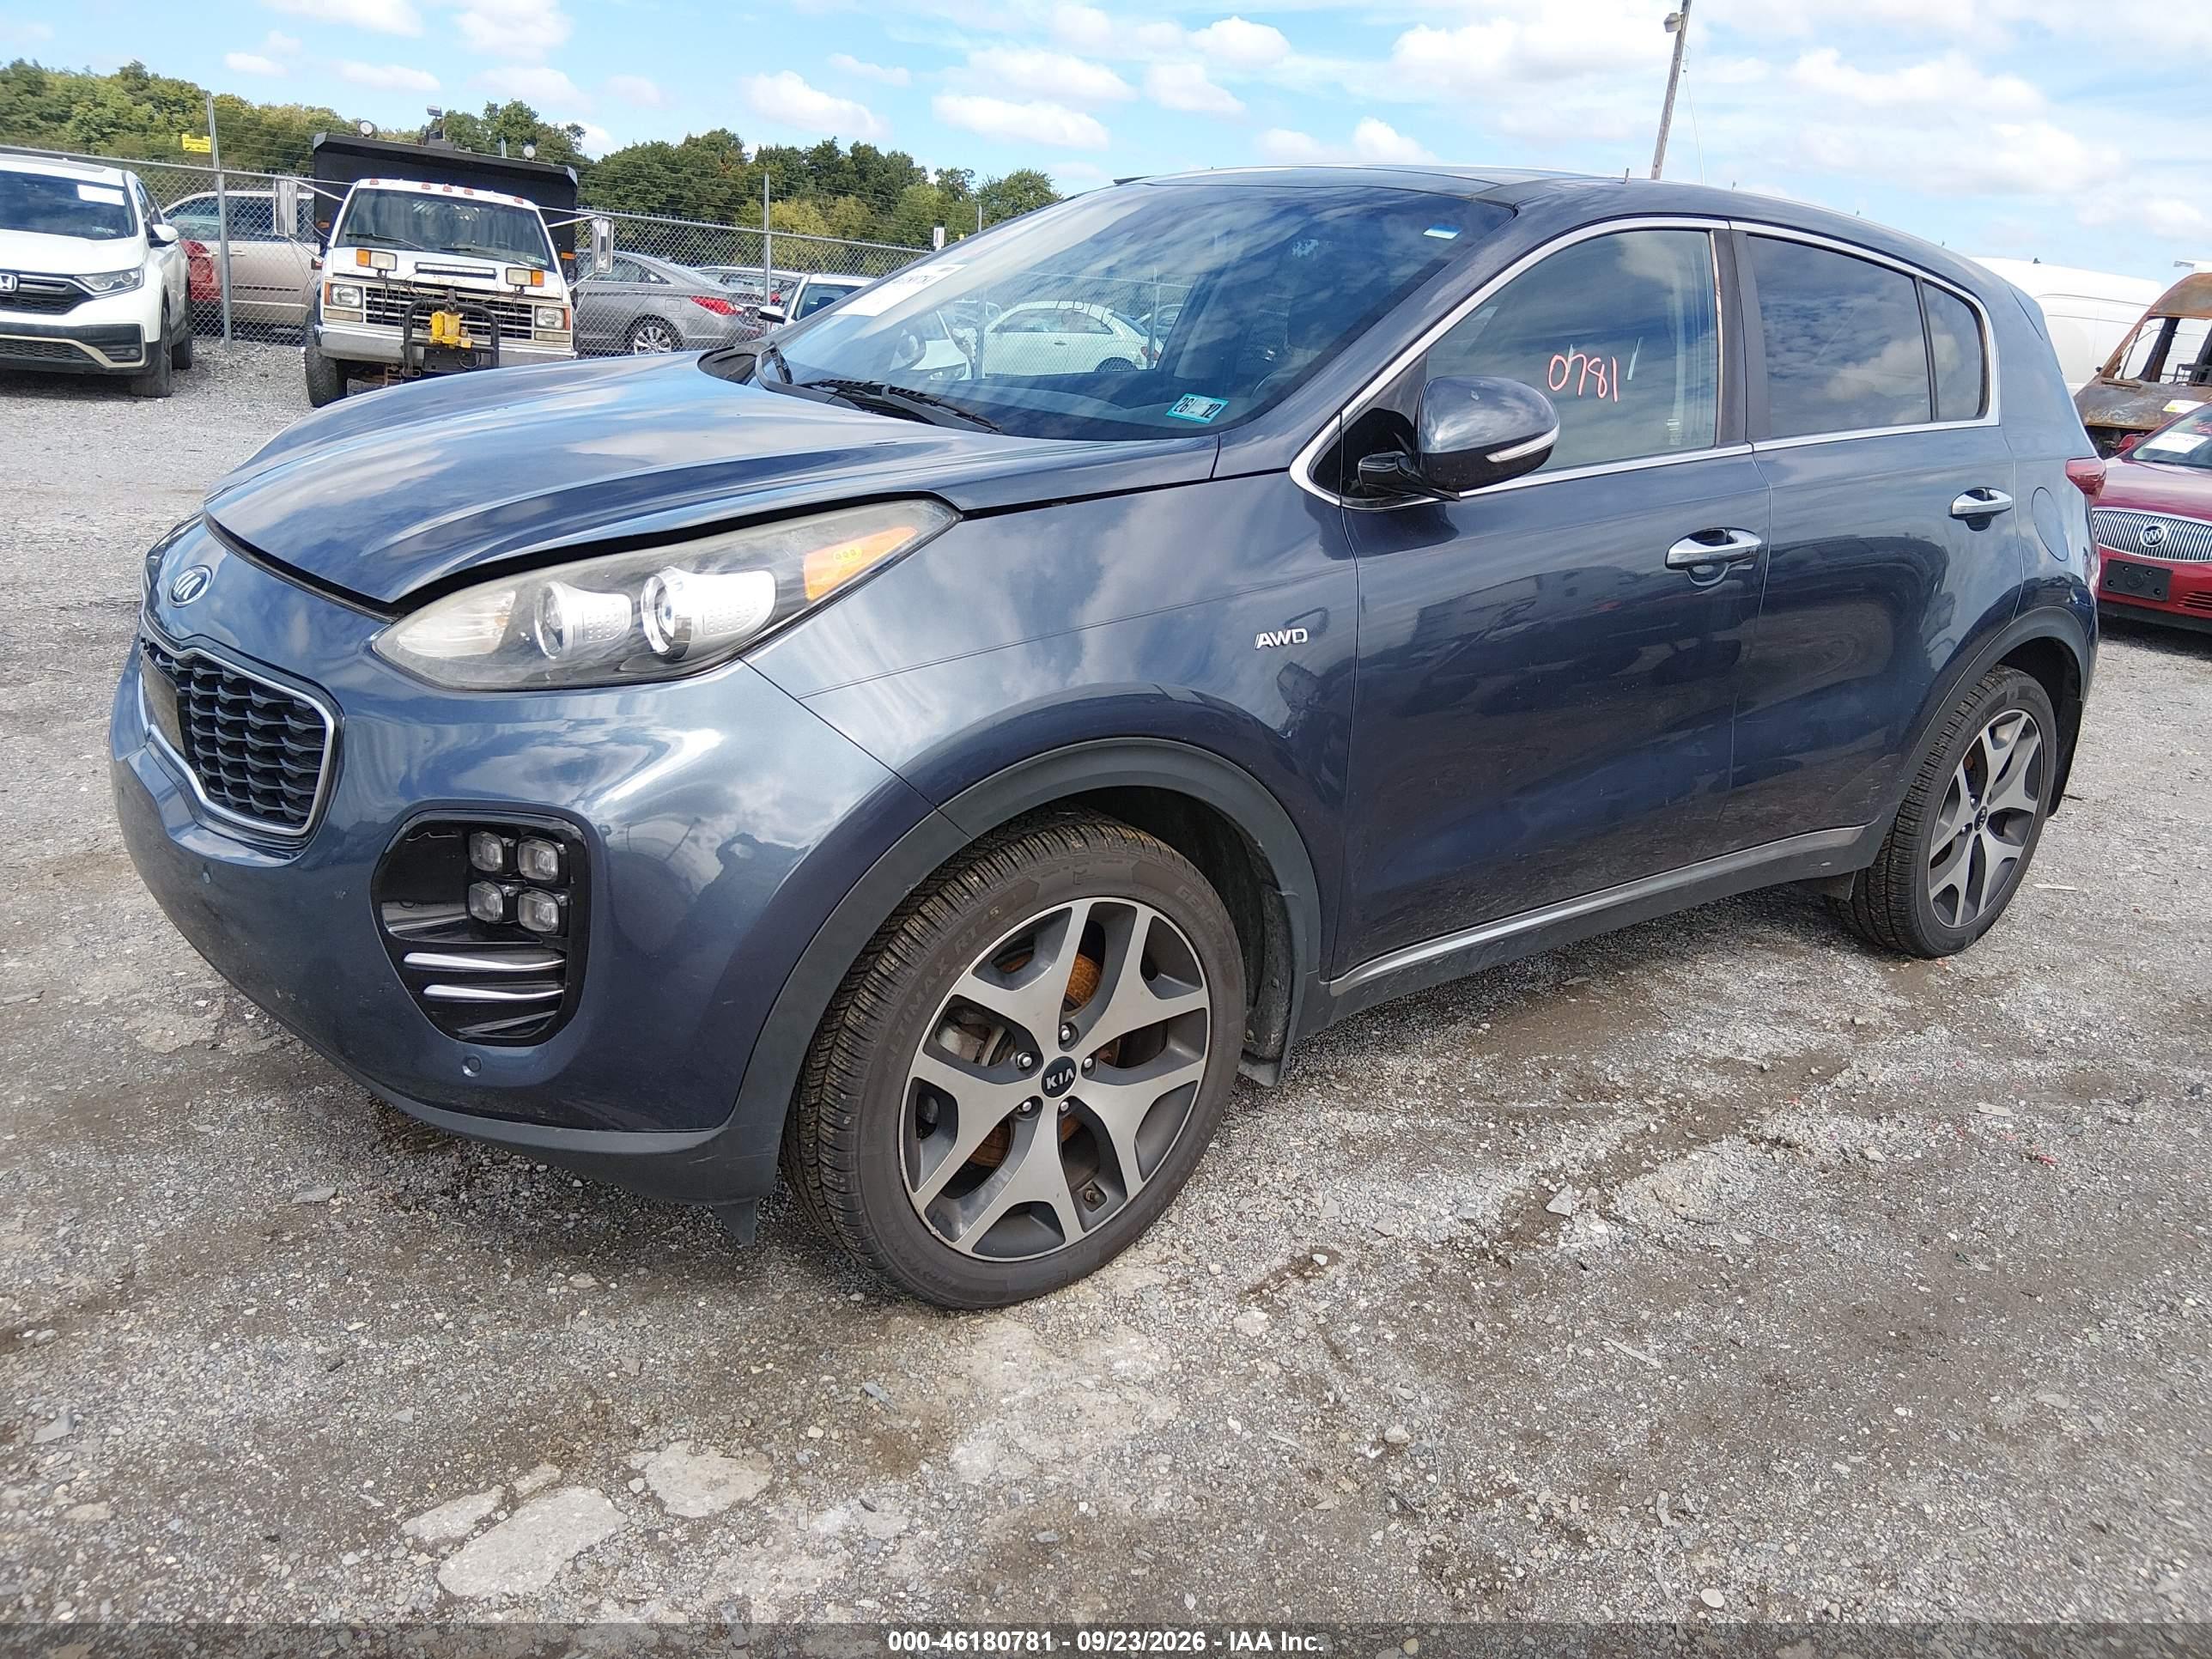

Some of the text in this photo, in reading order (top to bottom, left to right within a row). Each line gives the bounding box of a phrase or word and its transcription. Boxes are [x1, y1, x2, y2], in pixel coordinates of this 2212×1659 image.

[1548, 353, 1619, 403] 0781
[1173, 397, 1222, 419] 26 12
[1254, 628, 1309, 650] AWD
[1046, 1067, 1074, 1090] KIA
